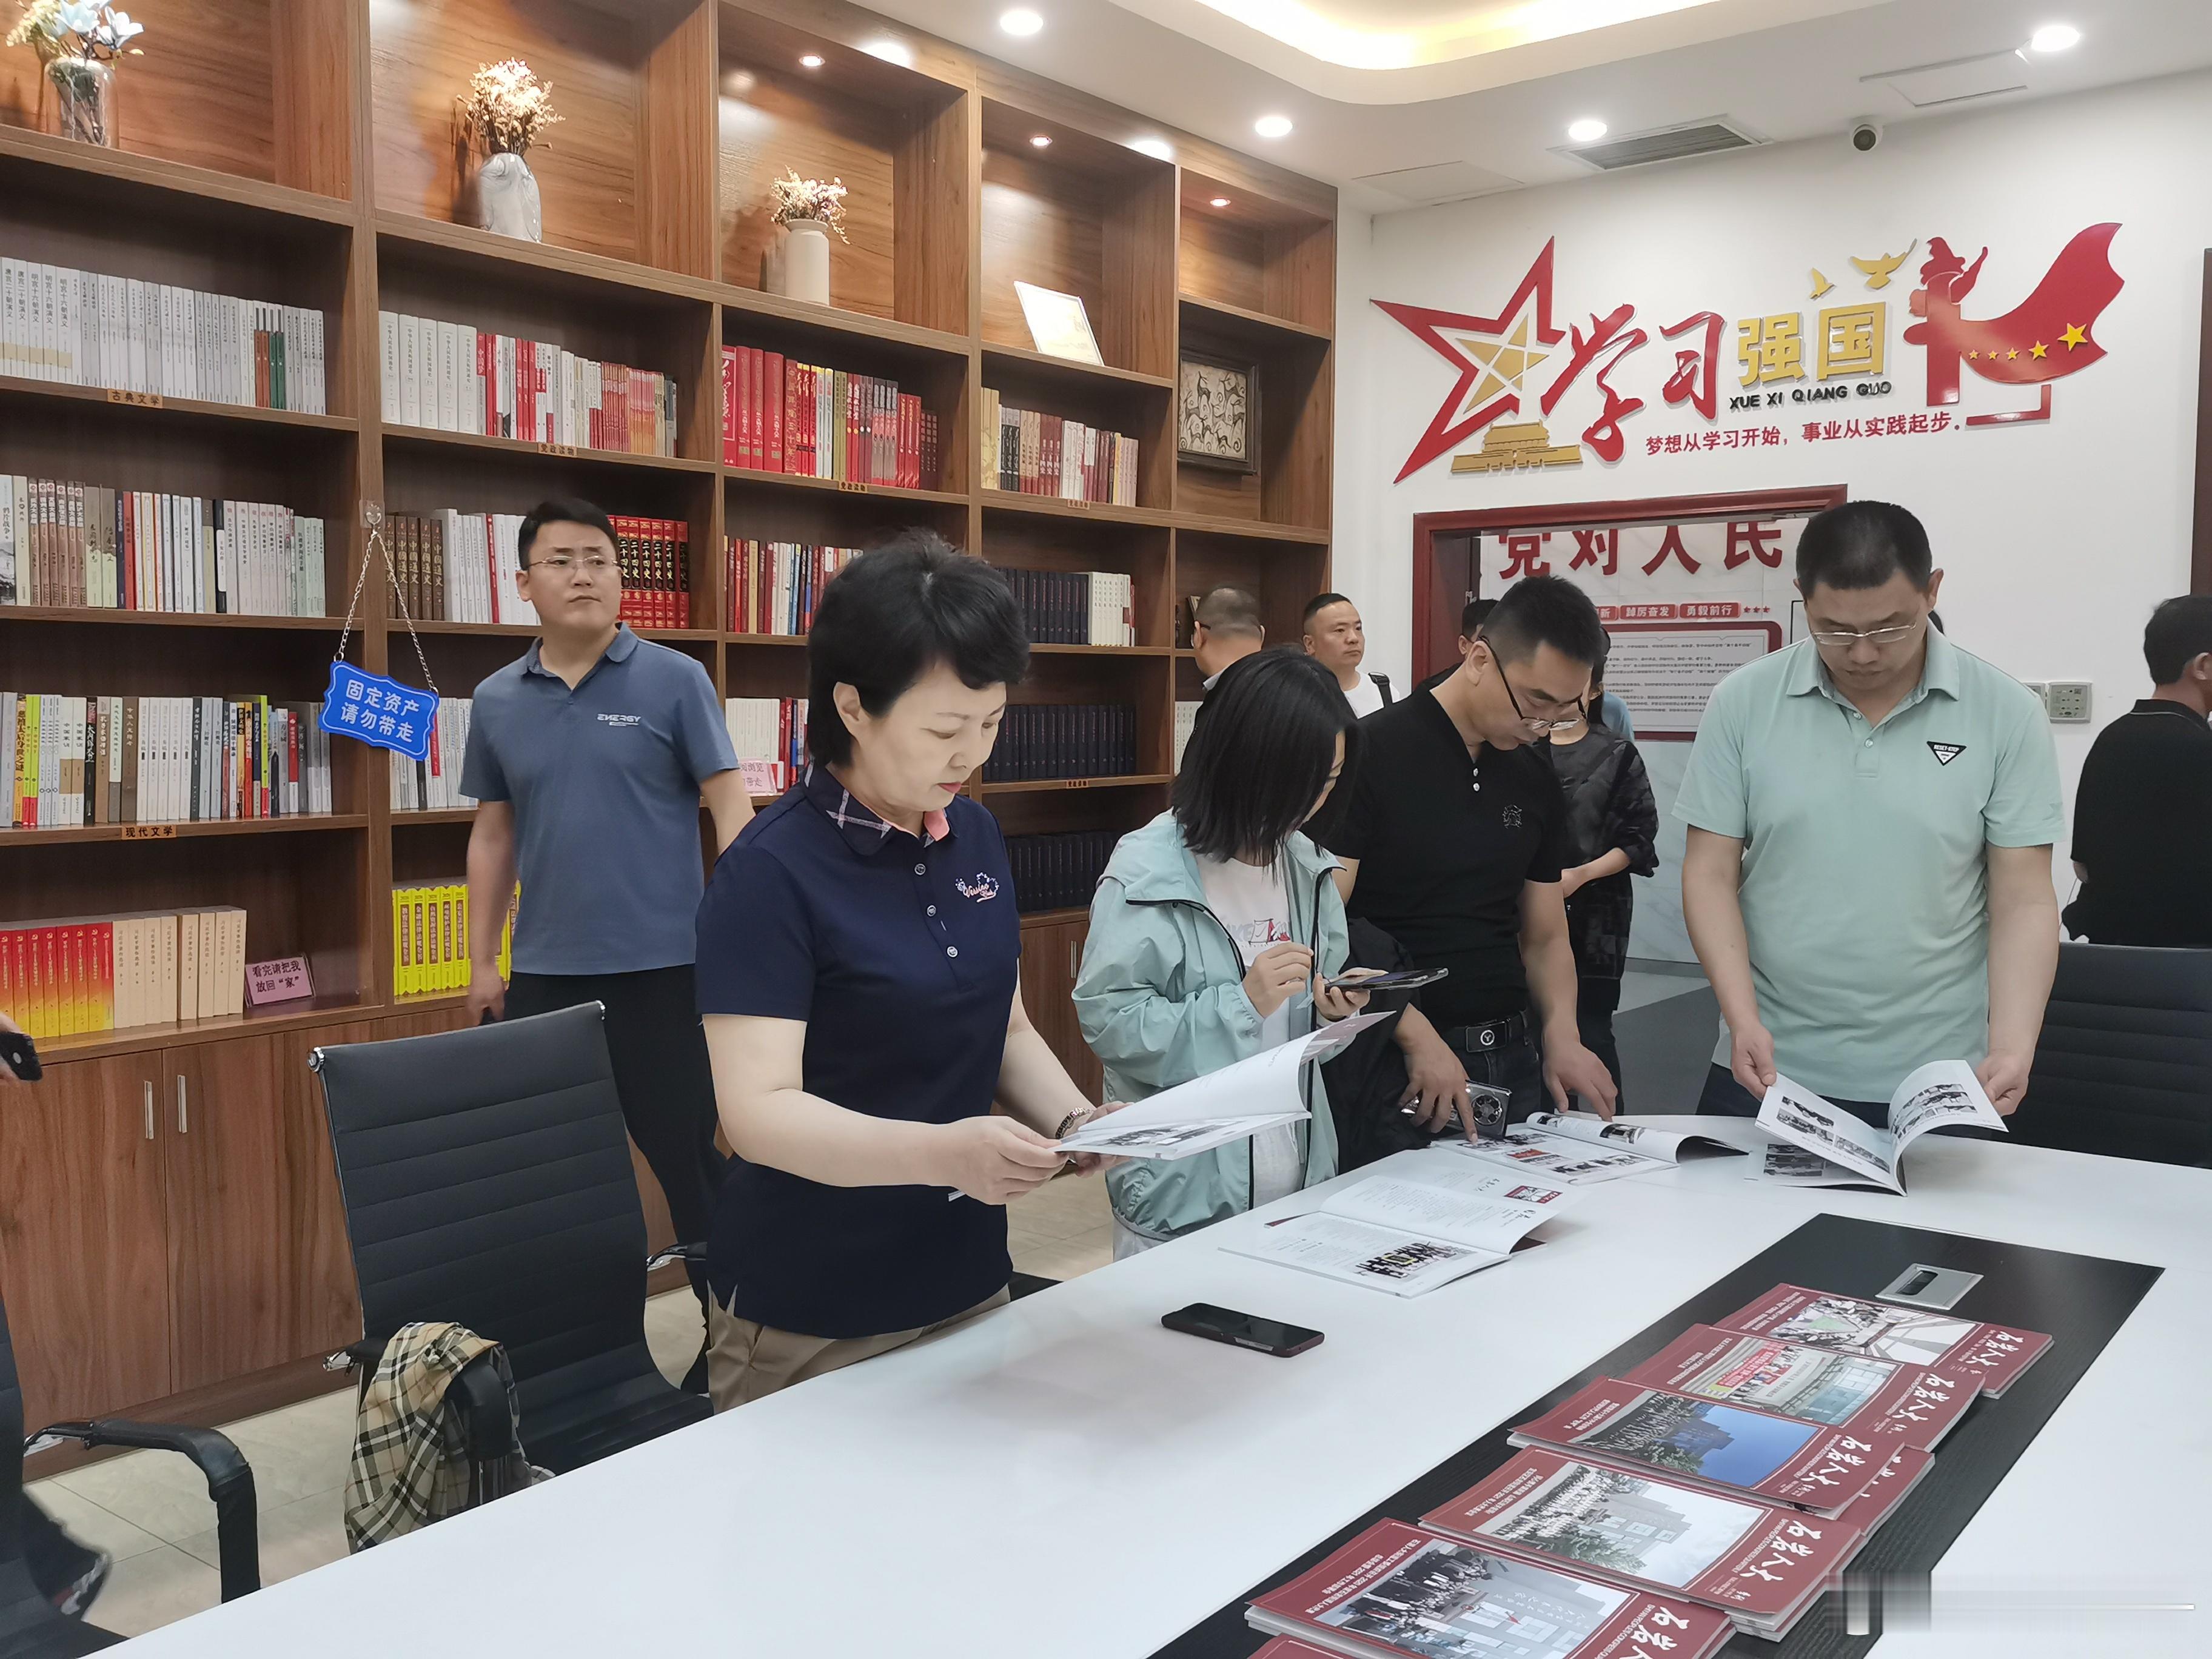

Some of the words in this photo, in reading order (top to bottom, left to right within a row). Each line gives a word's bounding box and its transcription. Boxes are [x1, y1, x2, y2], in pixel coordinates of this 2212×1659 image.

[112, 389, 160, 406] 古典文学
[1729, 394, 1761, 411] XUE
[1767, 392, 1784, 407] XI
[1791, 386, 1849, 403] QIANG
[1855, 381, 1893, 398] GUO
[398, 540, 407, 584] 中国通史
[409, 541, 418, 585] 中国通史
[422, 542, 432, 585] 中国通史
[434, 544, 443, 587] 中国通史
[630, 541, 640, 578] 二十四史
[642, 543, 651, 579] 二十四史
[654, 544, 663, 580] 二十四史
[1626, 606, 1669, 617] 踔厉奋发
[1686, 605, 1732, 617] 勇毅前行
[346, 680, 420, 717] 固定资产
[341, 702, 414, 743] 请勿带走
[597, 714, 642, 722] ENERGY
[126, 826, 173, 838] 现代文学
[252, 960, 301, 977] 看完请把我
[1740, 1520, 1822, 1581] 石岩人大
